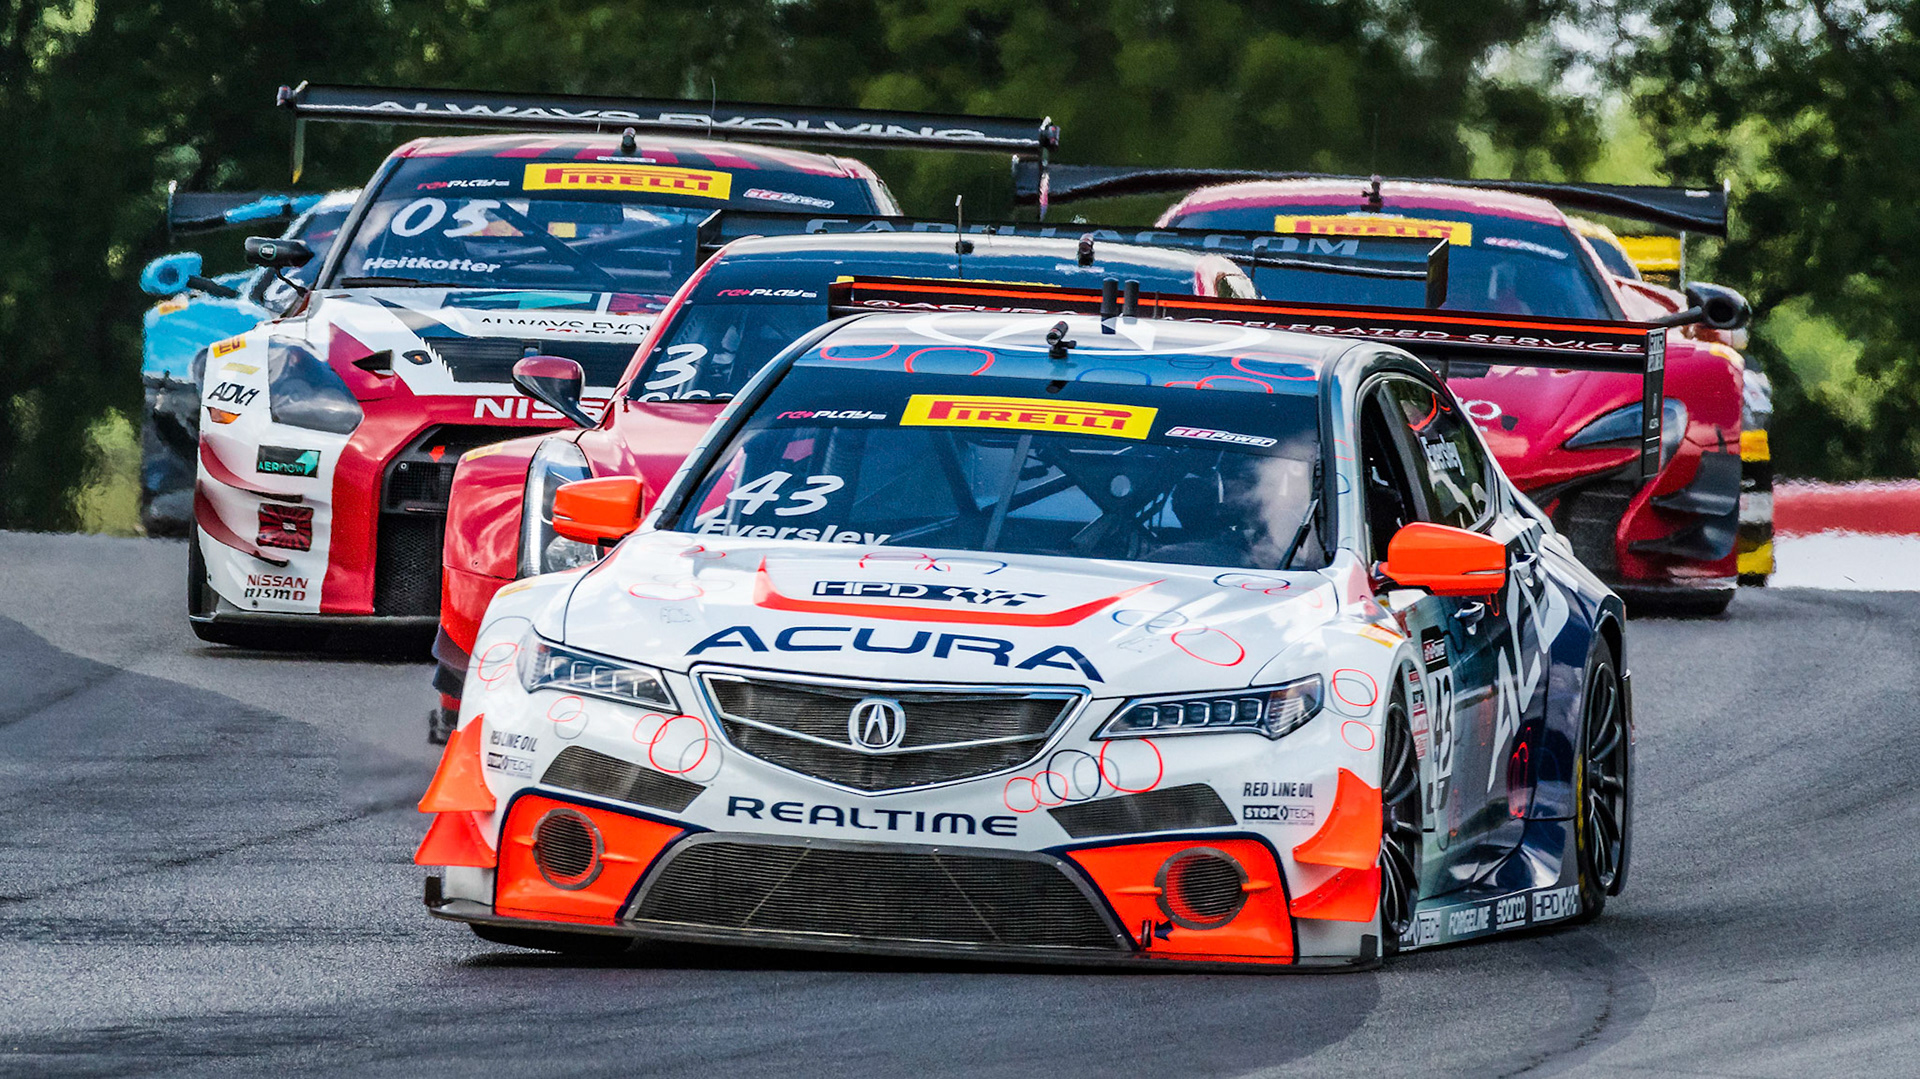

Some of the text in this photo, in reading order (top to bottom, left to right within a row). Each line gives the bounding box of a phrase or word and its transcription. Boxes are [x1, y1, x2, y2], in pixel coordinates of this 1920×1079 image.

[545, 168, 713, 191] PIRELLI
[391, 197, 500, 237] 05
[363, 257, 500, 273] Heitkotter
[901, 302, 1079, 315] ACUR
[1163, 316, 1451, 339] ELERATED
[1468, 334, 1641, 352] SERVICE
[644, 343, 708, 390] 3
[928, 400, 1132, 430] PIRELLI
[726, 471, 845, 516] 43
[247, 574, 309, 589] NISSAN
[814, 581, 928, 598] HPD
[685, 625, 1105, 684] ACURA
[1243, 782, 1313, 798] RED LINE OIL
[726, 797, 1018, 836] REALTIME
